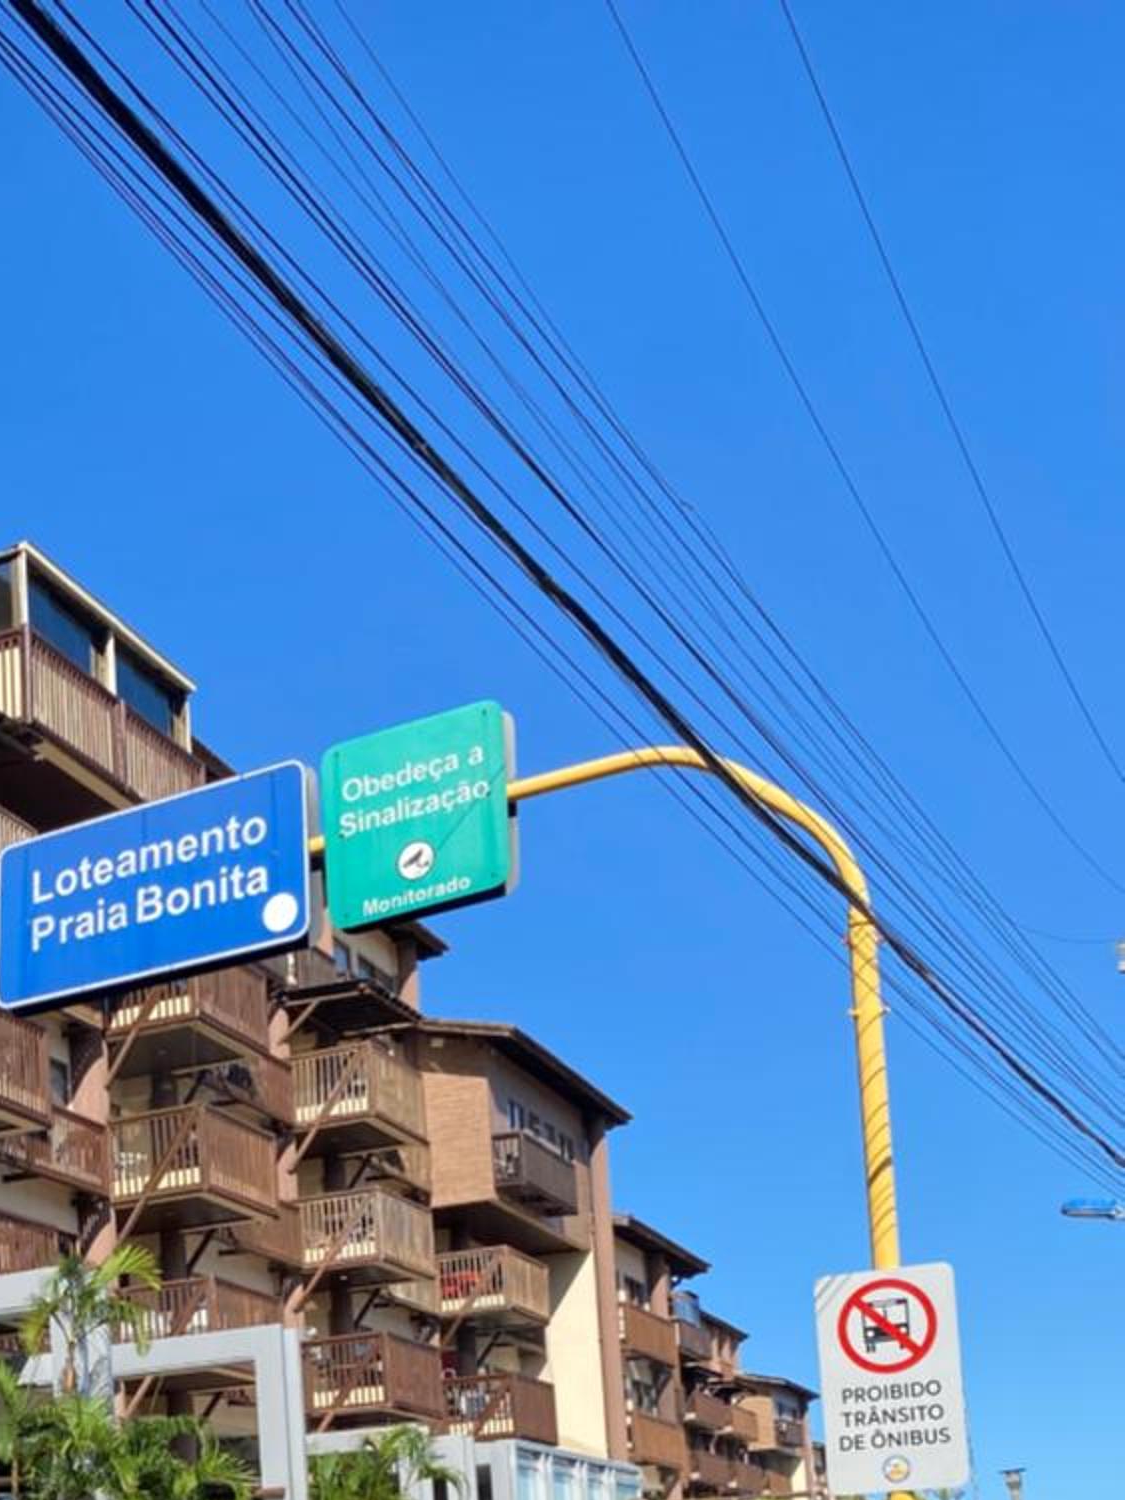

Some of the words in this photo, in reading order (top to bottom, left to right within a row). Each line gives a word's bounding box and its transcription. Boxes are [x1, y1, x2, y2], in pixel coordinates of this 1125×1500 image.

[342, 757, 461, 803] Obedeça
[468, 745, 485, 765] a
[339, 779, 491, 839] Sinalização
[31, 814, 268, 904] Loteamento
[31, 902, 129, 953] Praia
[136, 866, 269, 921] Bonita
[363, 875, 472, 917] Monitorado
[841, 1404, 944, 1428] TRÂNSITO
[842, 1380, 941, 1403] PROIBIDO
[838, 1435, 867, 1452] DE
[871, 1427, 951, 1450] ÔNIBUS
